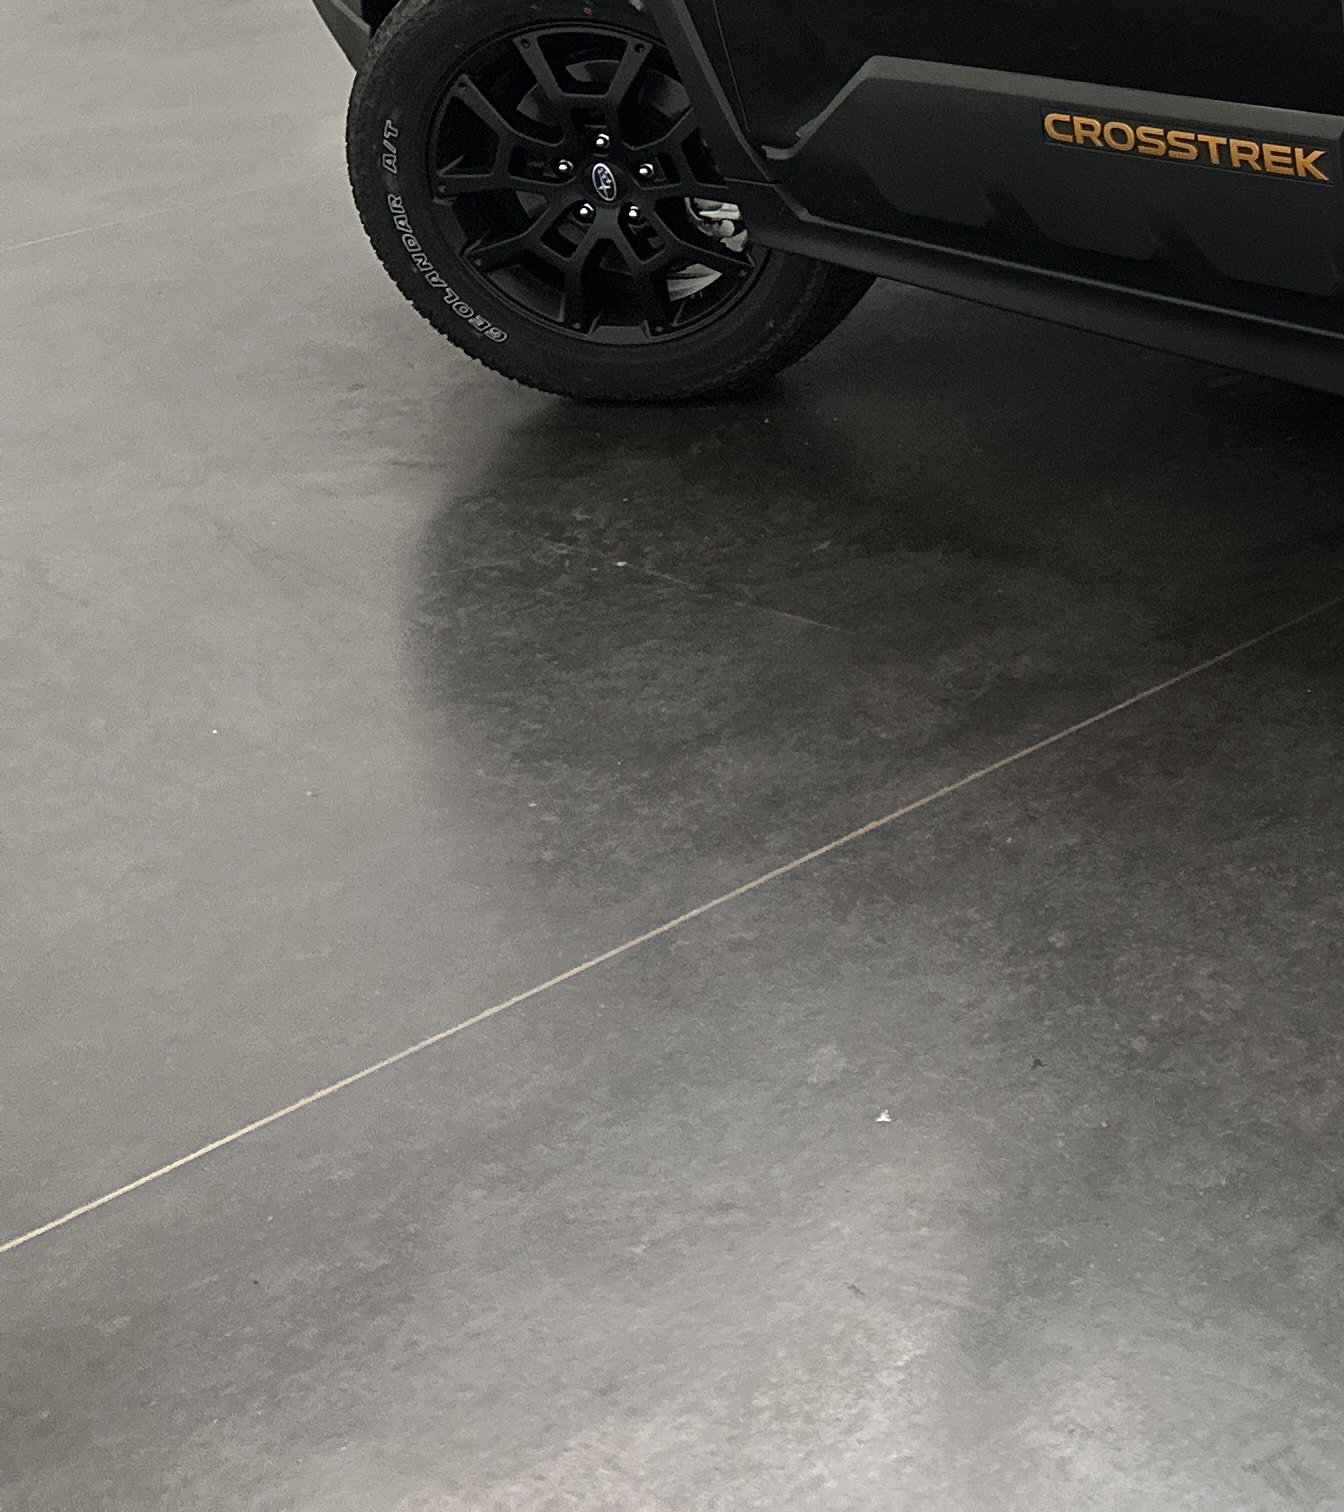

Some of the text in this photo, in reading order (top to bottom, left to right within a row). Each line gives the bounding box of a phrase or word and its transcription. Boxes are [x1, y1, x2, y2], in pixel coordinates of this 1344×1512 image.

[1044, 112, 1329, 181] CROSSTREK
[382, 119, 508, 343] GEOLANDAR A/T
